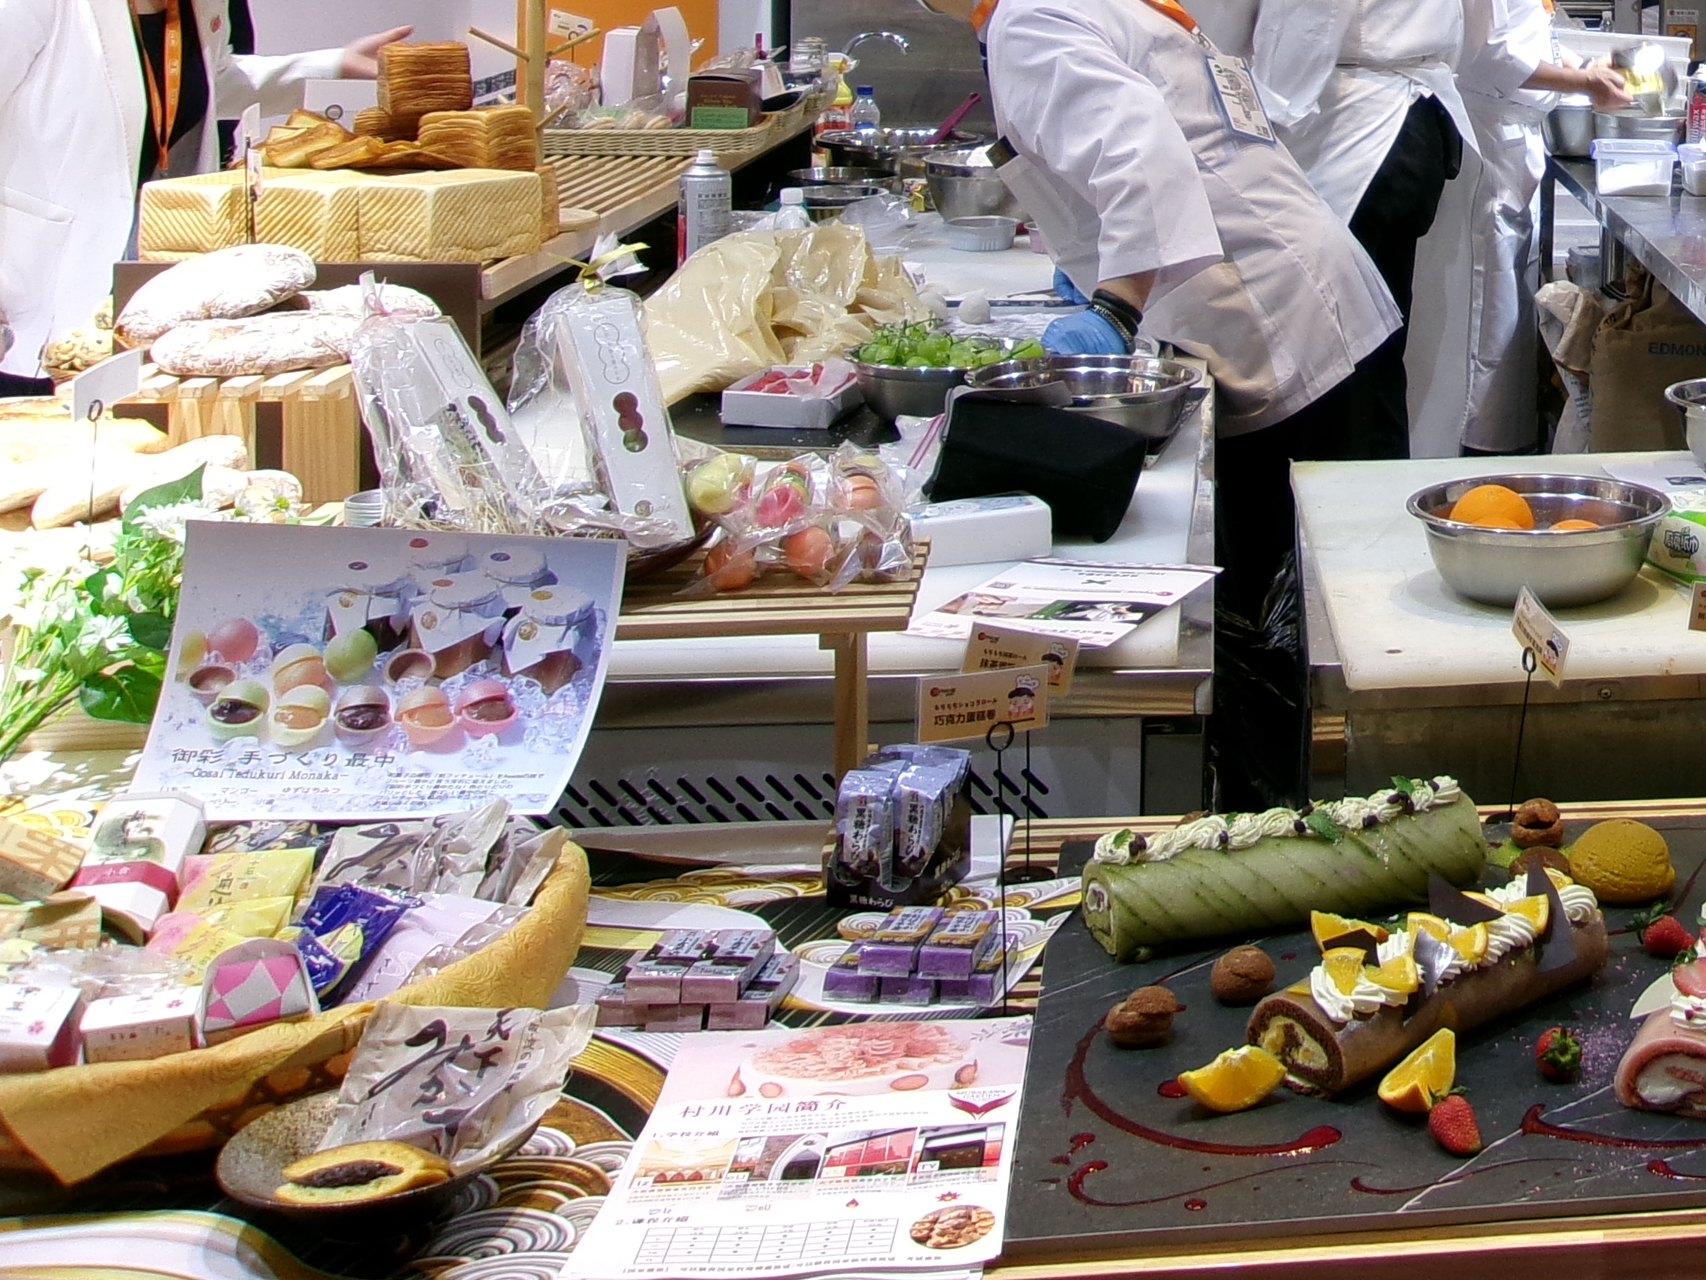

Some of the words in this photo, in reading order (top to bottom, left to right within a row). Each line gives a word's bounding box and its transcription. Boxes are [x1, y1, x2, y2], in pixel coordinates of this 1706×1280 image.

[172, 748, 222, 765] 御彩
[238, 750, 396, 769] 手づくり最中
[229, 768, 285, 780] Tedukuri
[680, 1098, 848, 1119] 村川学园简介
